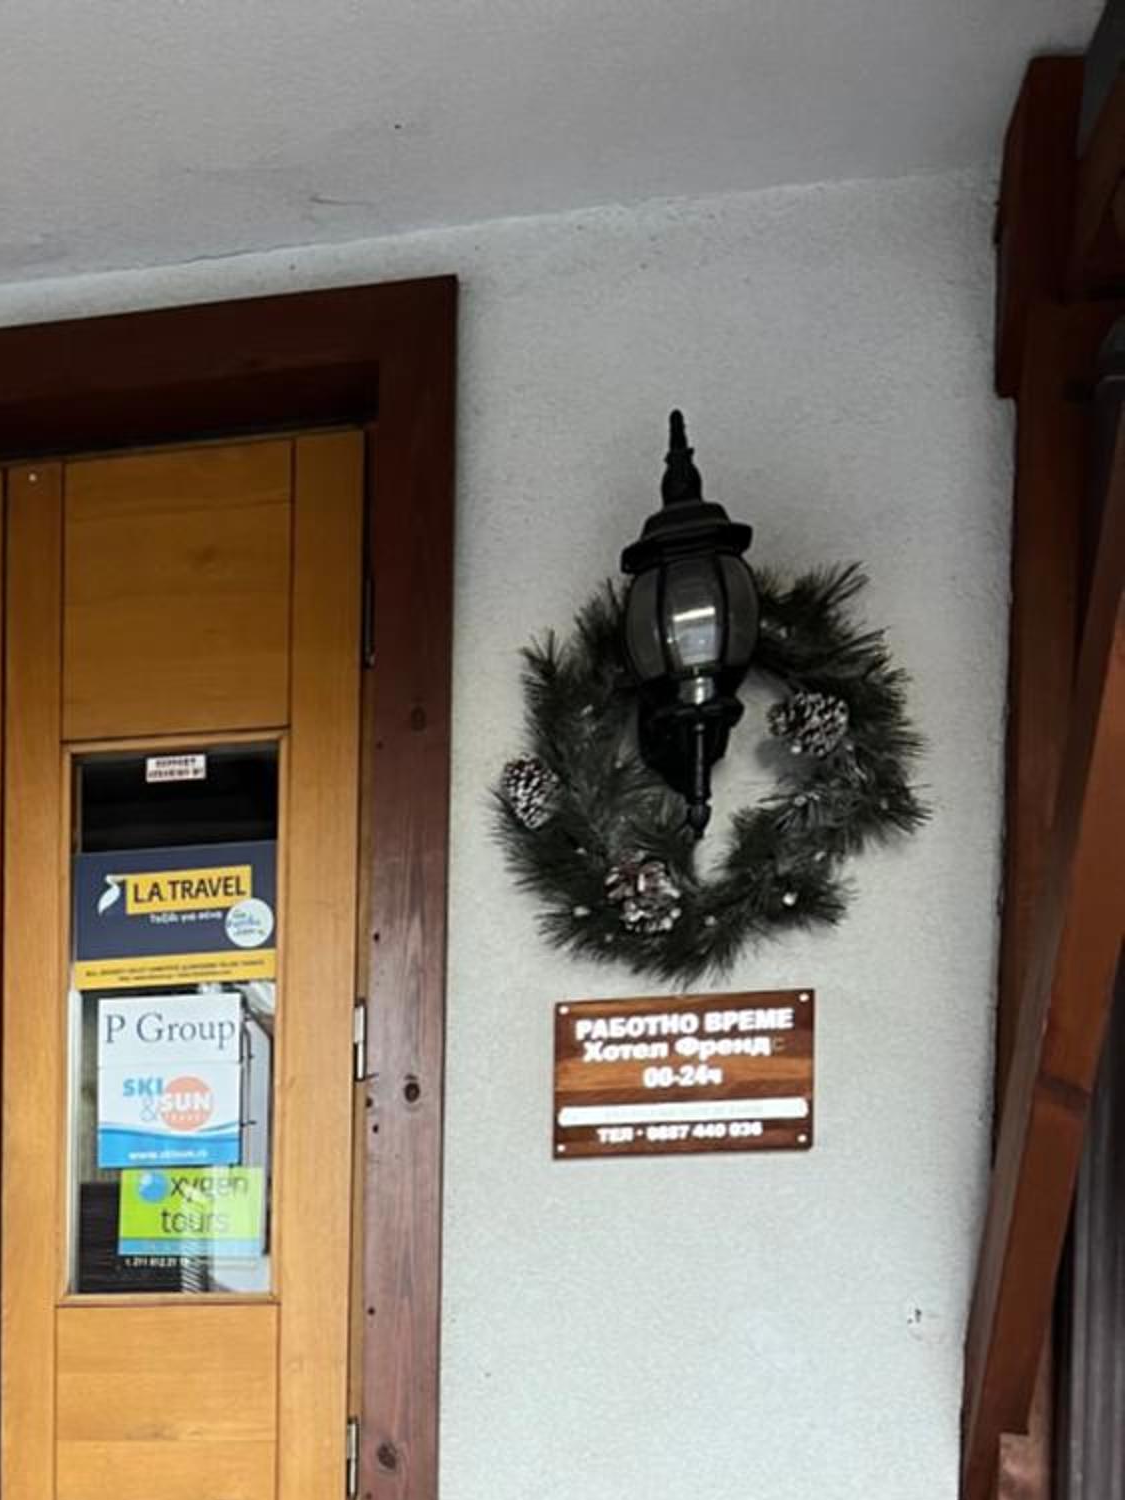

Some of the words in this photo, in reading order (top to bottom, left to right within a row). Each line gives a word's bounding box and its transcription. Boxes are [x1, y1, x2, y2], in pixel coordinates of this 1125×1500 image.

[167, 876, 247, 900] TRAVEL
[106, 1014, 126, 1043] P
[136, 1012, 235, 1050] Group
[576, 1013, 699, 1040] РАБОТНО
[704, 1008, 794, 1031] ВРЕМЕ
[583, 1039, 668, 1062] Хотел
[675, 1037, 771, 1060] Френд
[123, 1077, 164, 1097] SKI
[159, 1092, 213, 1111] SUN
[161, 1210, 231, 1233] tours
